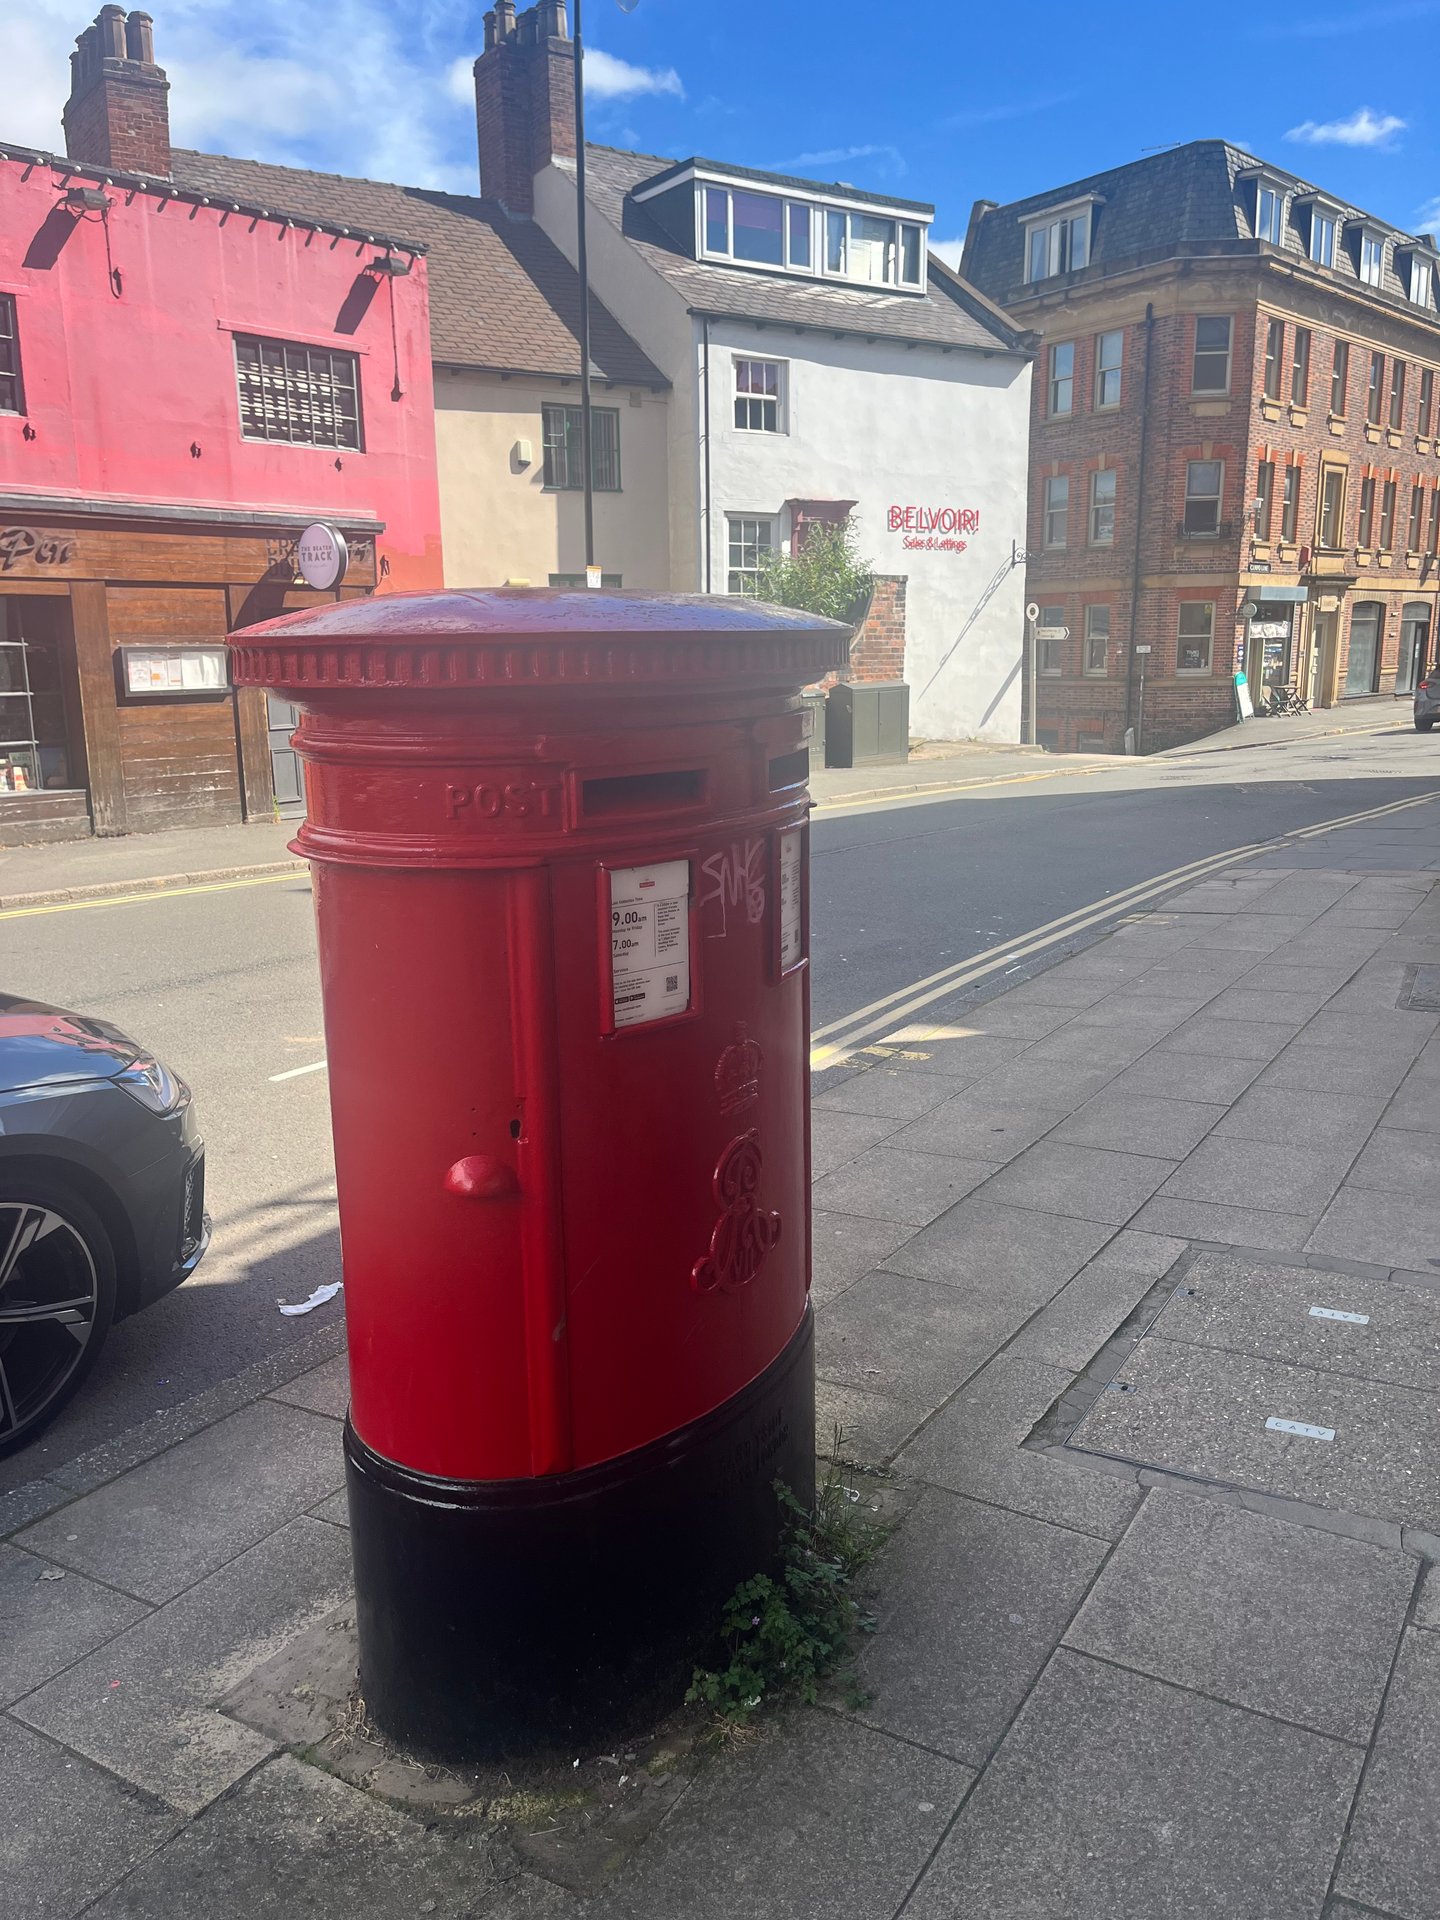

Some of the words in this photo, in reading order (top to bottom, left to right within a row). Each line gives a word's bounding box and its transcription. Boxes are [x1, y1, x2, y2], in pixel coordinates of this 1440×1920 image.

[890, 505, 980, 532] BELVOIR!
[903, 535, 925, 549] Sales
[926, 537, 934, 549] &
[934, 537, 968, 552] Lettings
[301, 551, 333, 562] TRACK
[446, 780, 562, 819] POST
[612, 911, 647, 926] 9.00am
[612, 939, 639, 950] 7.00am
[1274, 1421, 1326, 1436] CATV
